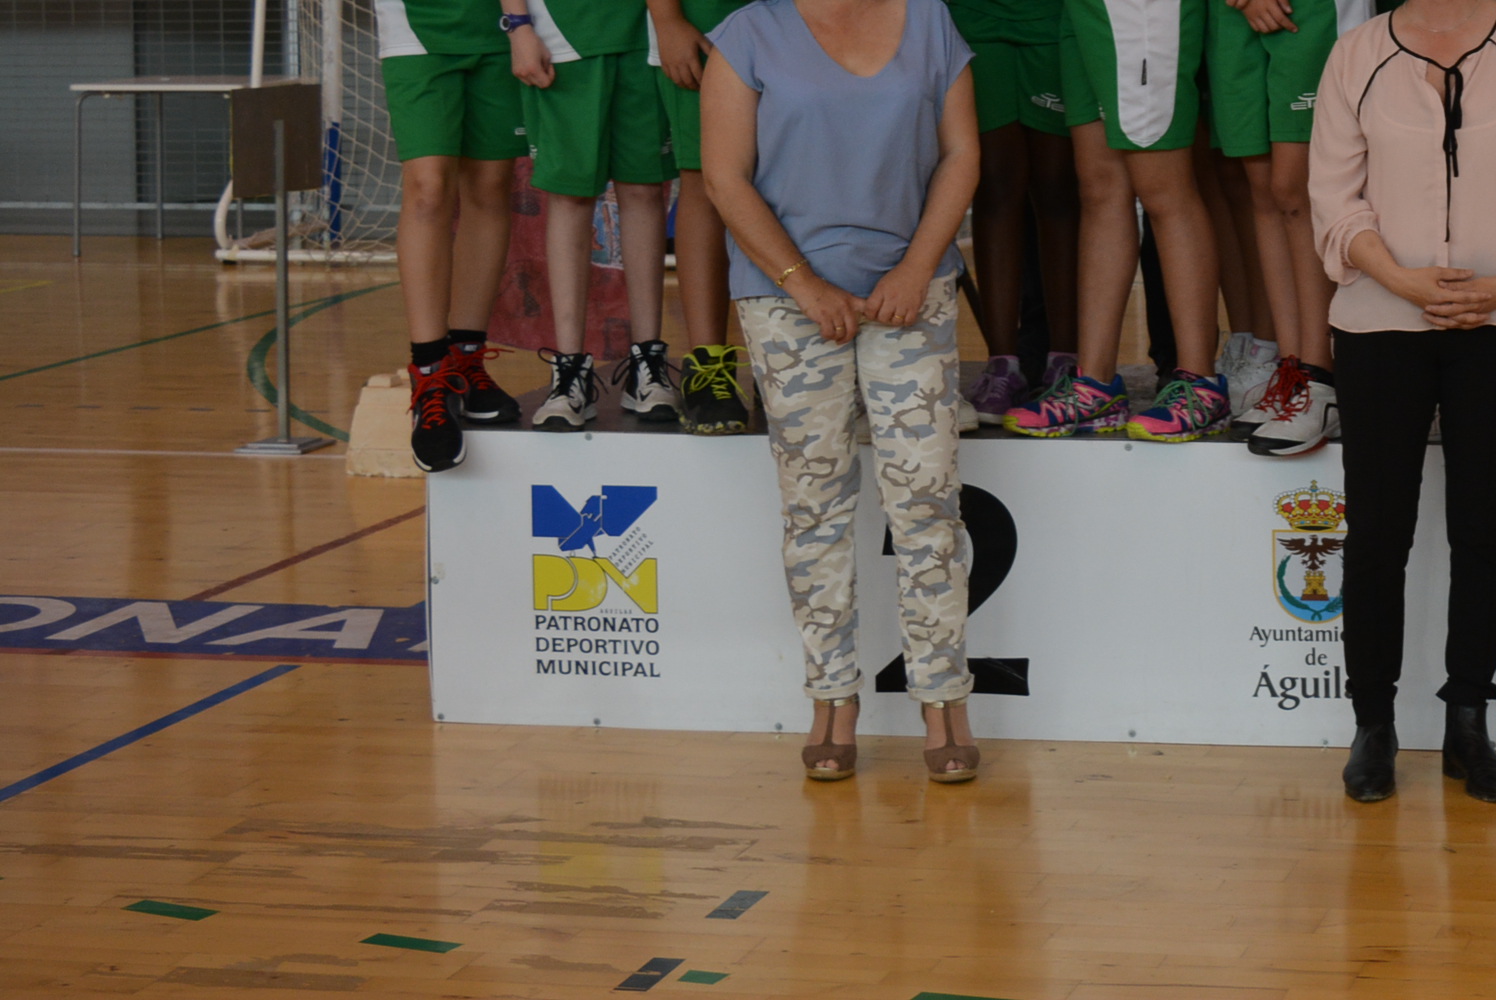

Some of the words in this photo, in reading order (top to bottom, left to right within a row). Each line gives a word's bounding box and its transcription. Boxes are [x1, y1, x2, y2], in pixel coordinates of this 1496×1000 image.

[534, 615, 660, 634] PATRONATO
[535, 637, 660, 656] DEPORTIVO
[1305, 647, 1328, 666] de
[536, 659, 661, 678] MUNICIPAL
